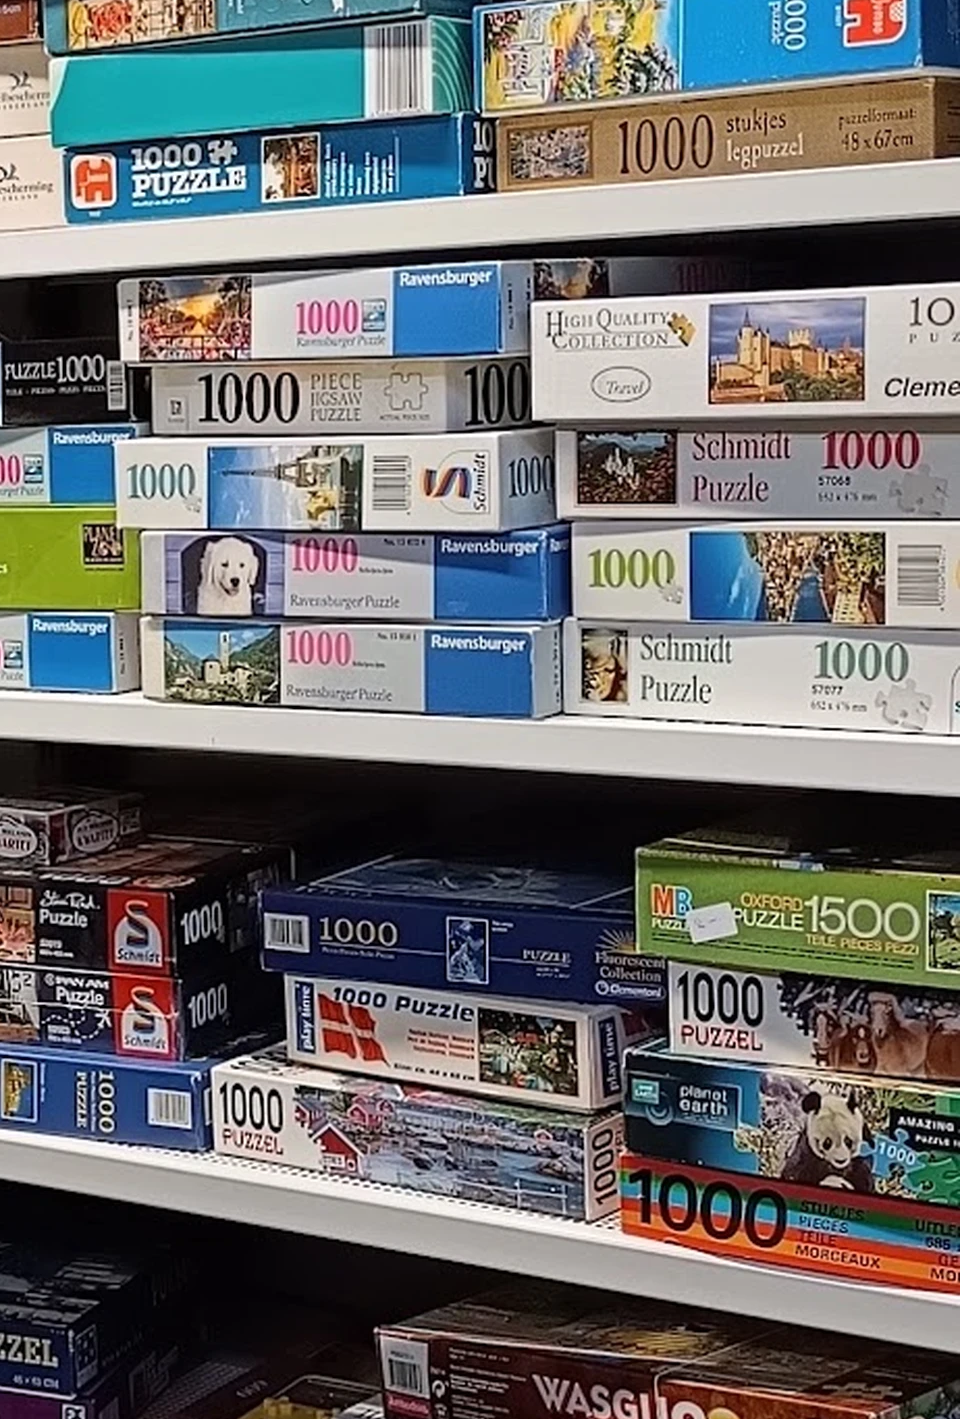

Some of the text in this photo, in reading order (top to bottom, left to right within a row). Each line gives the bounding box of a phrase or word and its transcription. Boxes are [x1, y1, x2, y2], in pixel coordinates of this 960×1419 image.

[617, 107, 787, 176] 1000 stukjes
[726, 135, 804, 169] legpuzzel
[131, 144, 202, 172] 1000
[131, 165, 247, 200] PUZZLE
[399, 268, 492, 287] Ravensburger
[295, 298, 359, 336] 1000
[546, 307, 671, 339] HIGH QUALITY
[552, 328, 670, 349] COLLECTION
[4, 354, 105, 383] PUZZLE 1000
[309, 373, 363, 391] PIECE
[197, 370, 302, 425] 1000
[309, 390, 363, 407] JIGSAW
[604, 378, 646, 397] Travel
[309, 407, 362, 423] PUZZLE
[52, 430, 131, 447] Ravensburger
[691, 431, 791, 462] Schmidt
[821, 429, 921, 471] 1000
[126, 462, 196, 501] 1000
[473, 451, 488, 513] Schmidt
[691, 472, 770, 504] Puzzle
[290, 536, 359, 573] 1000
[441, 537, 539, 556] Ravensburger
[587, 548, 675, 589] 1000
[289, 592, 401, 610] Ravensburger Puzzle
[31, 618, 110, 636] Ravensburger
[286, 629, 353, 666] 1000
[430, 633, 526, 653] Ravensburger
[640, 634, 733, 665] Schmidt
[814, 639, 910, 683] 1000
[285, 684, 393, 703] Ravensburger Puzzle
[640, 673, 713, 704] Puzzle
[650, 883, 693, 917] MB
[740, 891, 805, 912] OXFORD
[39, 909, 89, 928] Puzzle
[318, 916, 399, 948] 1000
[734, 894, 922, 943] PUZZLE 1500
[522, 948, 572, 965] PUZZLE
[804, 933, 921, 957] TEILE PIECES PEZZI
[599, 966, 663, 983] Collection
[55, 986, 105, 1006] Puzzle
[332, 985, 476, 1023] 1000 Puzzle
[676, 970, 765, 1028] 1000
[680, 1025, 764, 1053] PUZZEL
[76, 1071, 88, 1129] PUZZLE
[98, 1070, 115, 1134] 1000
[219, 1082, 284, 1134] 1000
[678, 1084, 730, 1106] planet
[678, 1097, 730, 1117] earth
[897, 1115, 955, 1133] AMAZING
[221, 1129, 284, 1156] PUZZEL
[878, 1141, 917, 1166] 1000
[627, 1167, 789, 1250] 1000
[800, 1200, 866, 1222] STUKJES
[798, 1214, 850, 1234] PIECES
[794, 1244, 882, 1271] MORCEAUX
